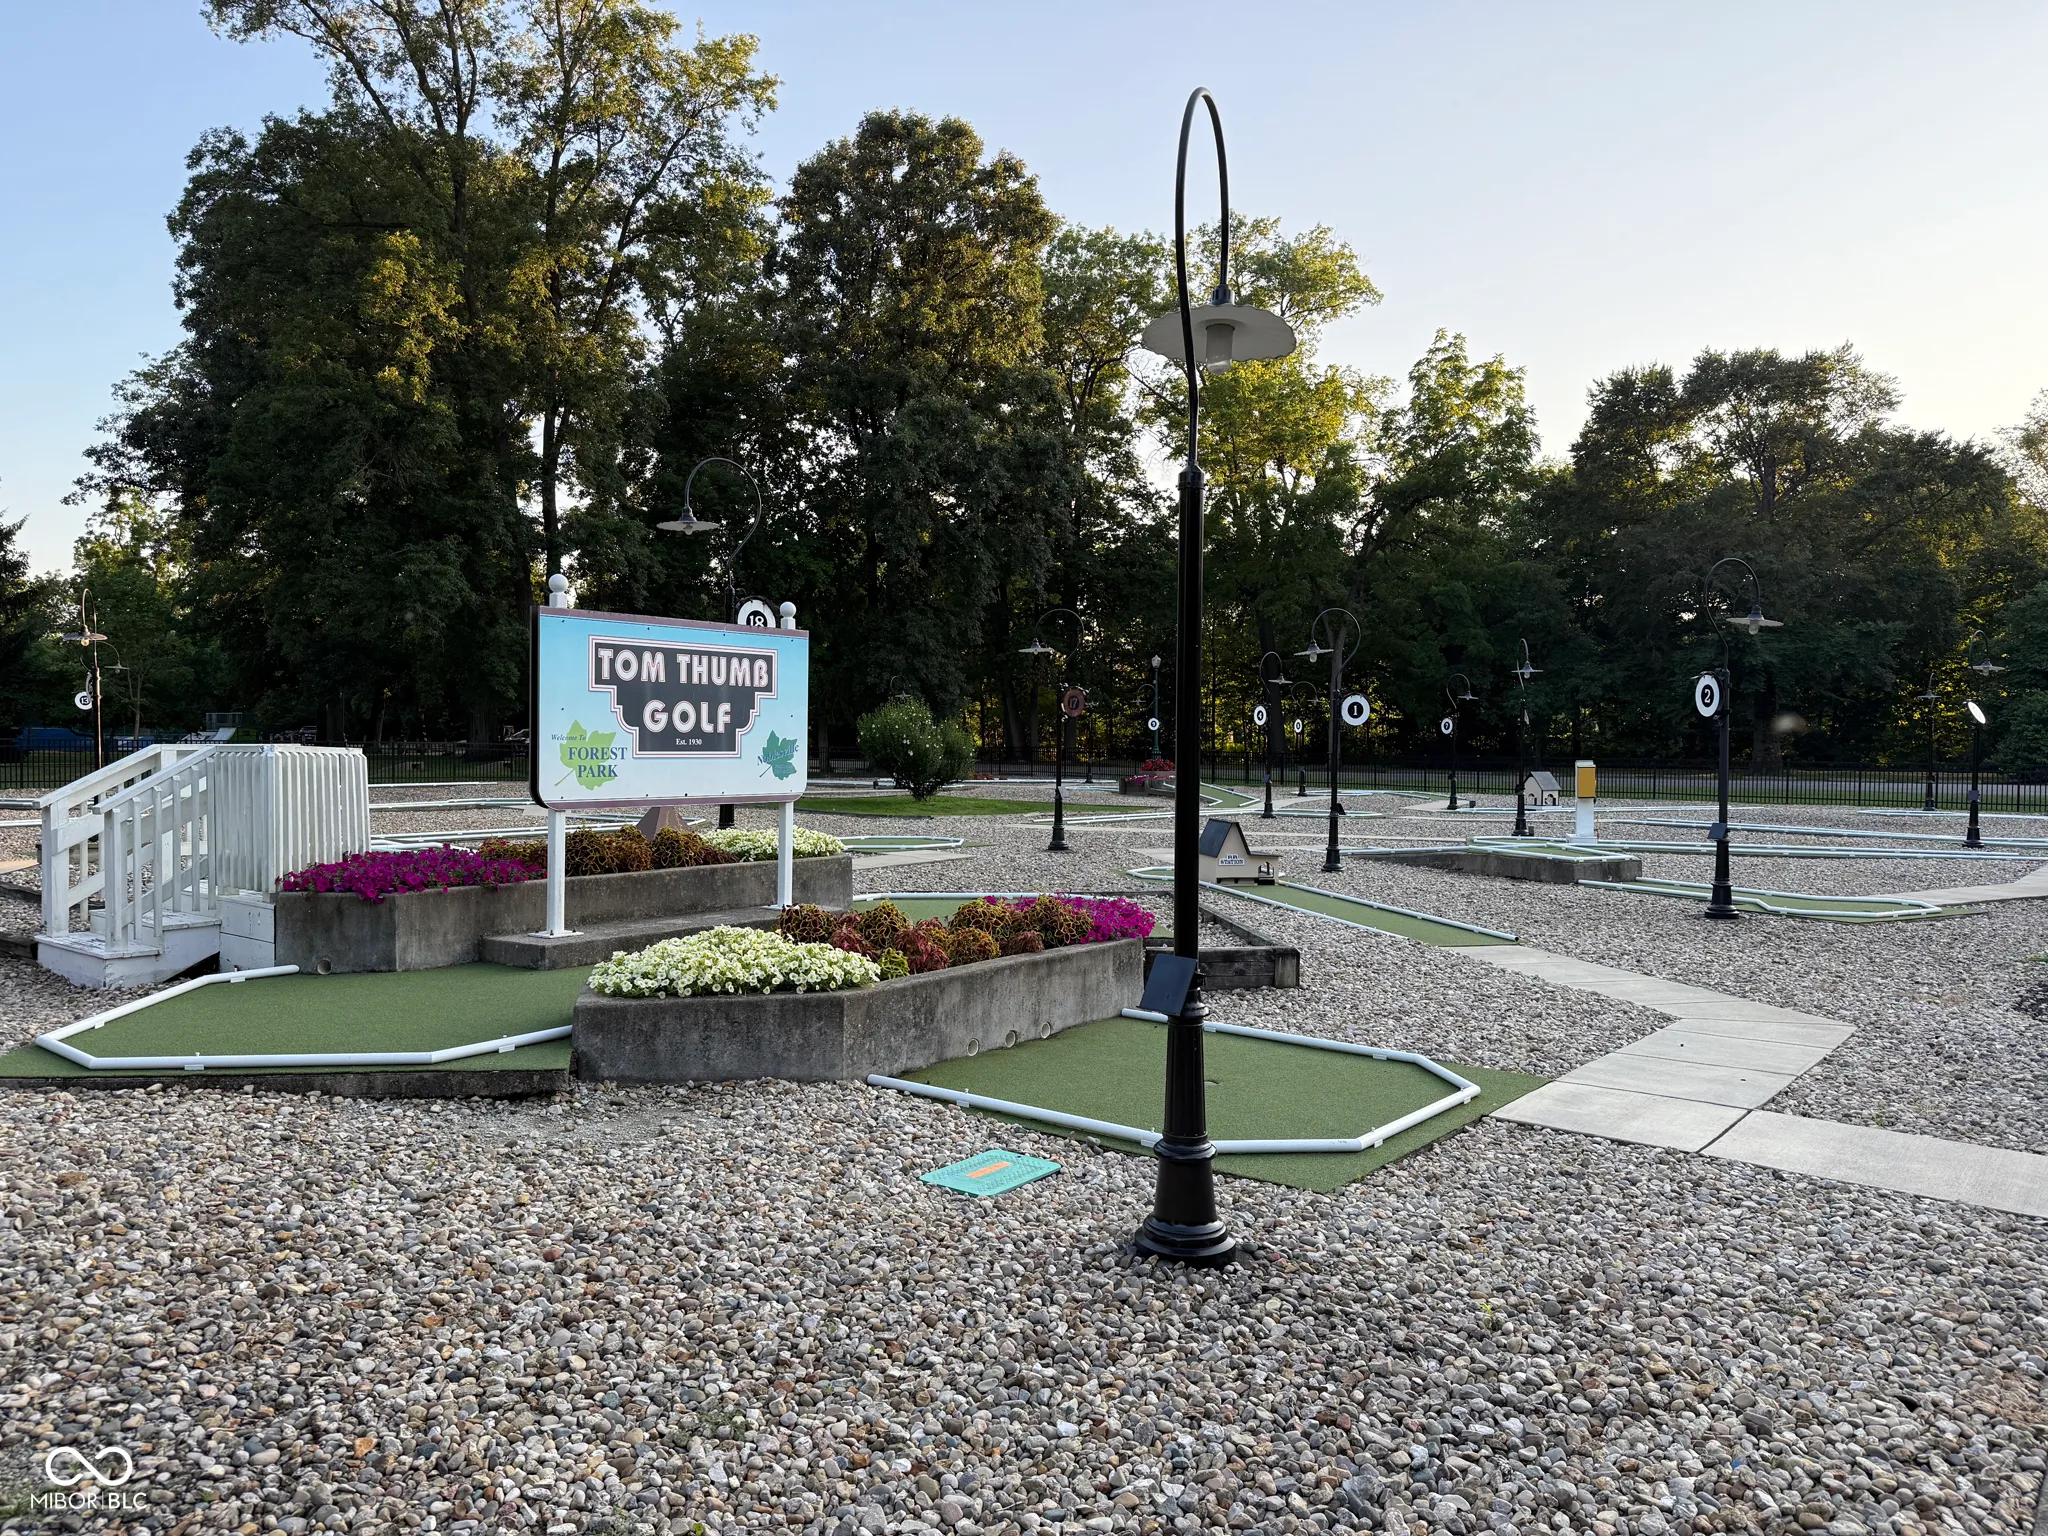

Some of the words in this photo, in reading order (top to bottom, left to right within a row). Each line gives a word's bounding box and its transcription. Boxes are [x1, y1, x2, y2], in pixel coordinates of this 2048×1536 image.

[598, 648, 666, 682] TOM
[676, 653, 769, 688] THUMB
[1704, 688, 1711, 703] 2
[643, 699, 731, 733] GOLF
[1353, 705, 1358, 716] 1
[675, 738, 688, 746] Est.
[688, 738, 703, 746] 1930
[568, 747, 628, 760] FOREST
[577, 764, 619, 778] PARK
